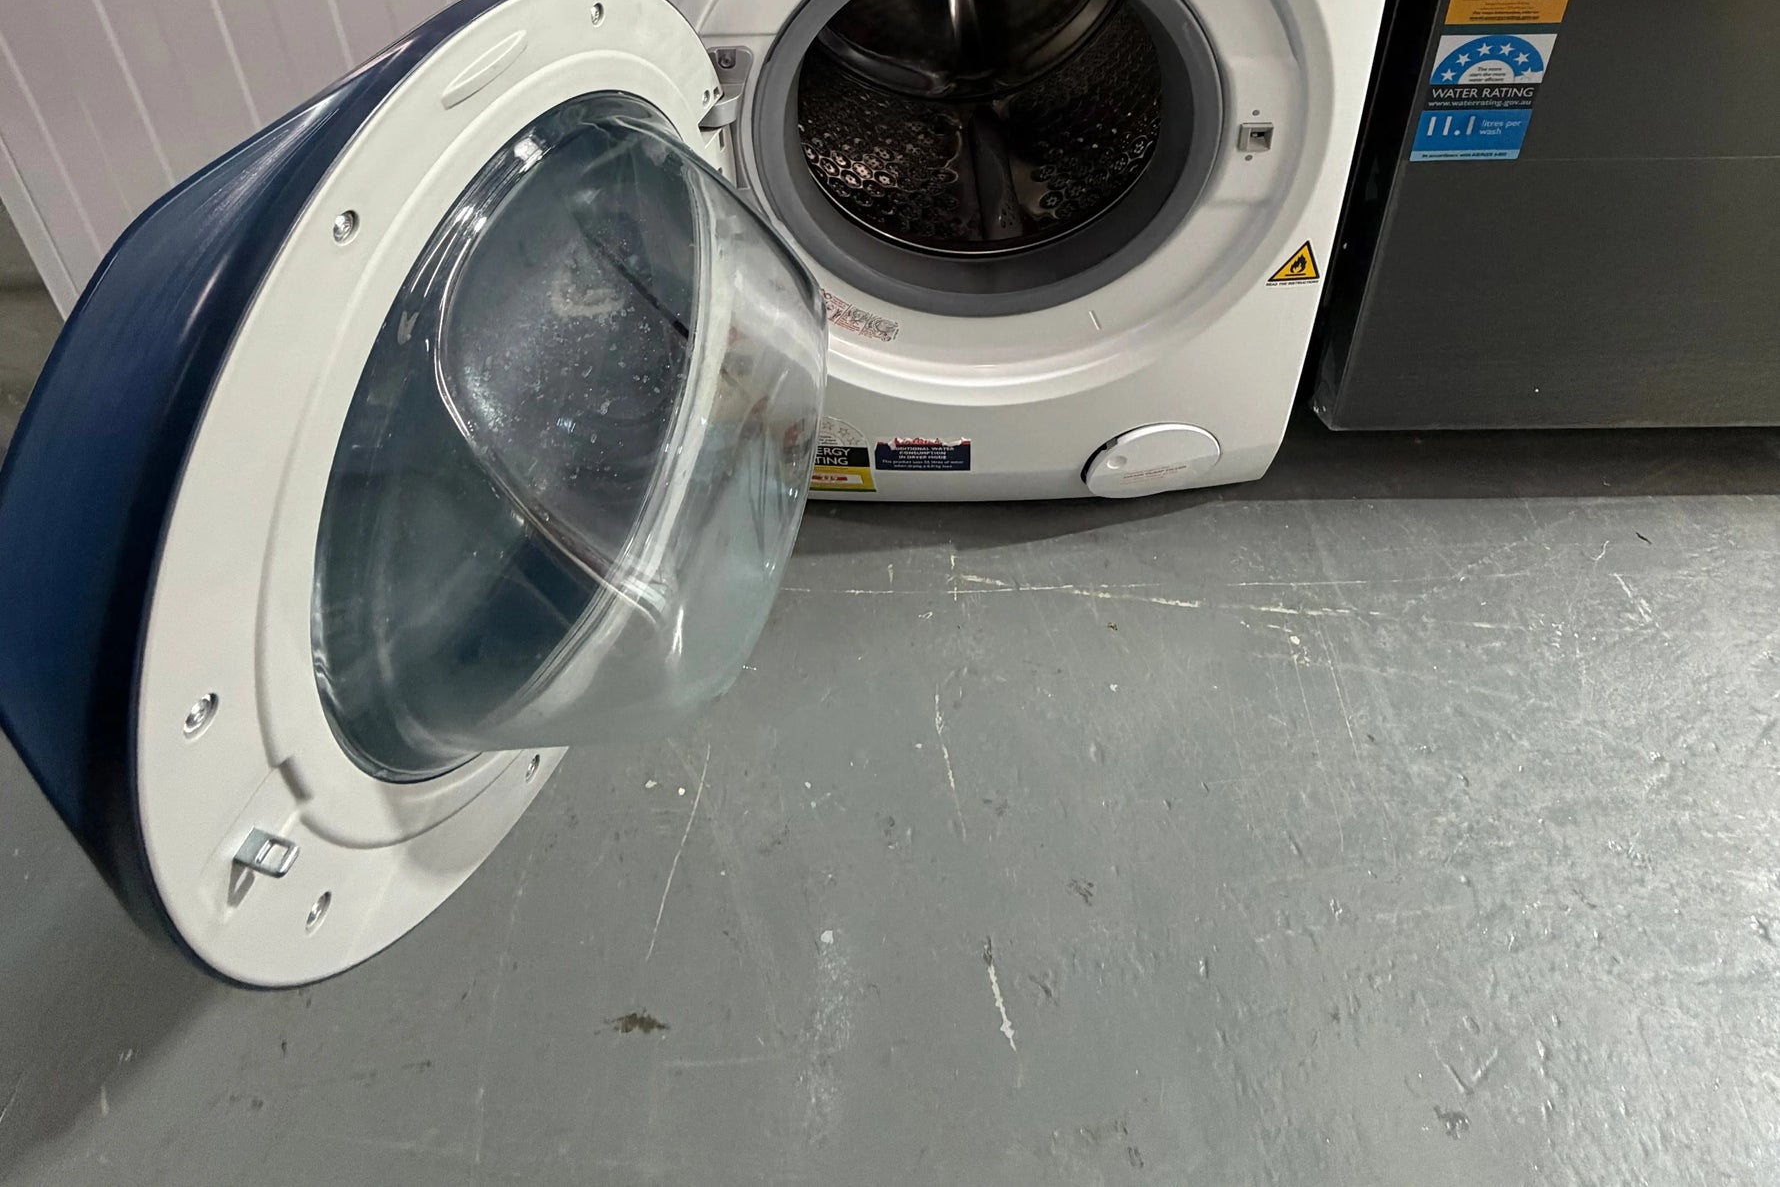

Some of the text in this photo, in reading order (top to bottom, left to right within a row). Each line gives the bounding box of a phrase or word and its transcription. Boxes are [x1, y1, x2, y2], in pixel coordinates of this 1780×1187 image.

[1432, 87, 1534, 98] WATER RATING
[1428, 99, 1531, 107] www.waterrating.gov.au
[1427, 116, 1476, 136] 11.1
[816, 447, 850, 456] ERGY
[814, 457, 848, 465] TING
